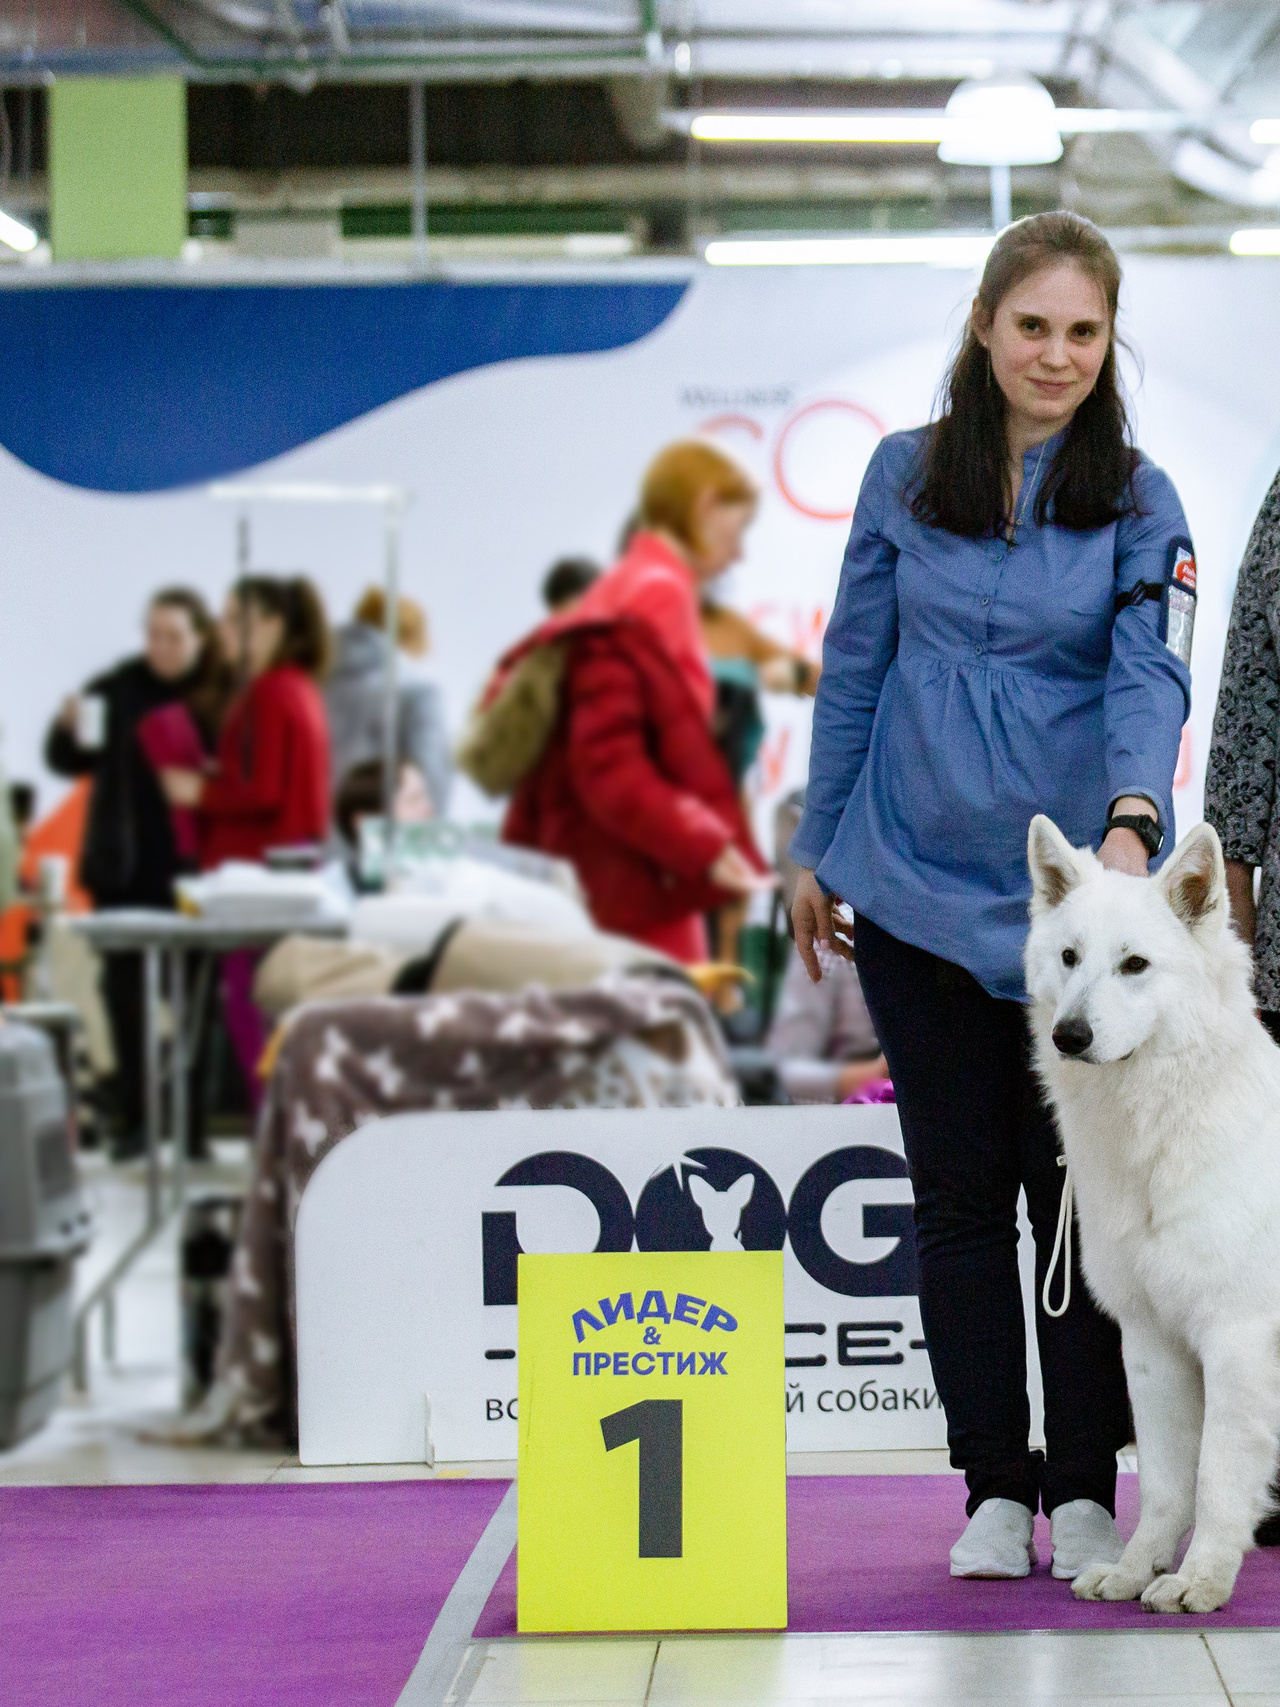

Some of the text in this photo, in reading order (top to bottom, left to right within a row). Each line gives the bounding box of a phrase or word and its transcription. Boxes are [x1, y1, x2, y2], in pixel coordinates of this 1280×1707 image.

[572, 1290, 738, 1344] ЛИДЕР
[642, 1326, 662, 1345] &
[572, 1351, 728, 1376] ПРЕСТИЖ
[816, 1379, 942, 1412] собаки
[600, 1399, 683, 1558] 1
